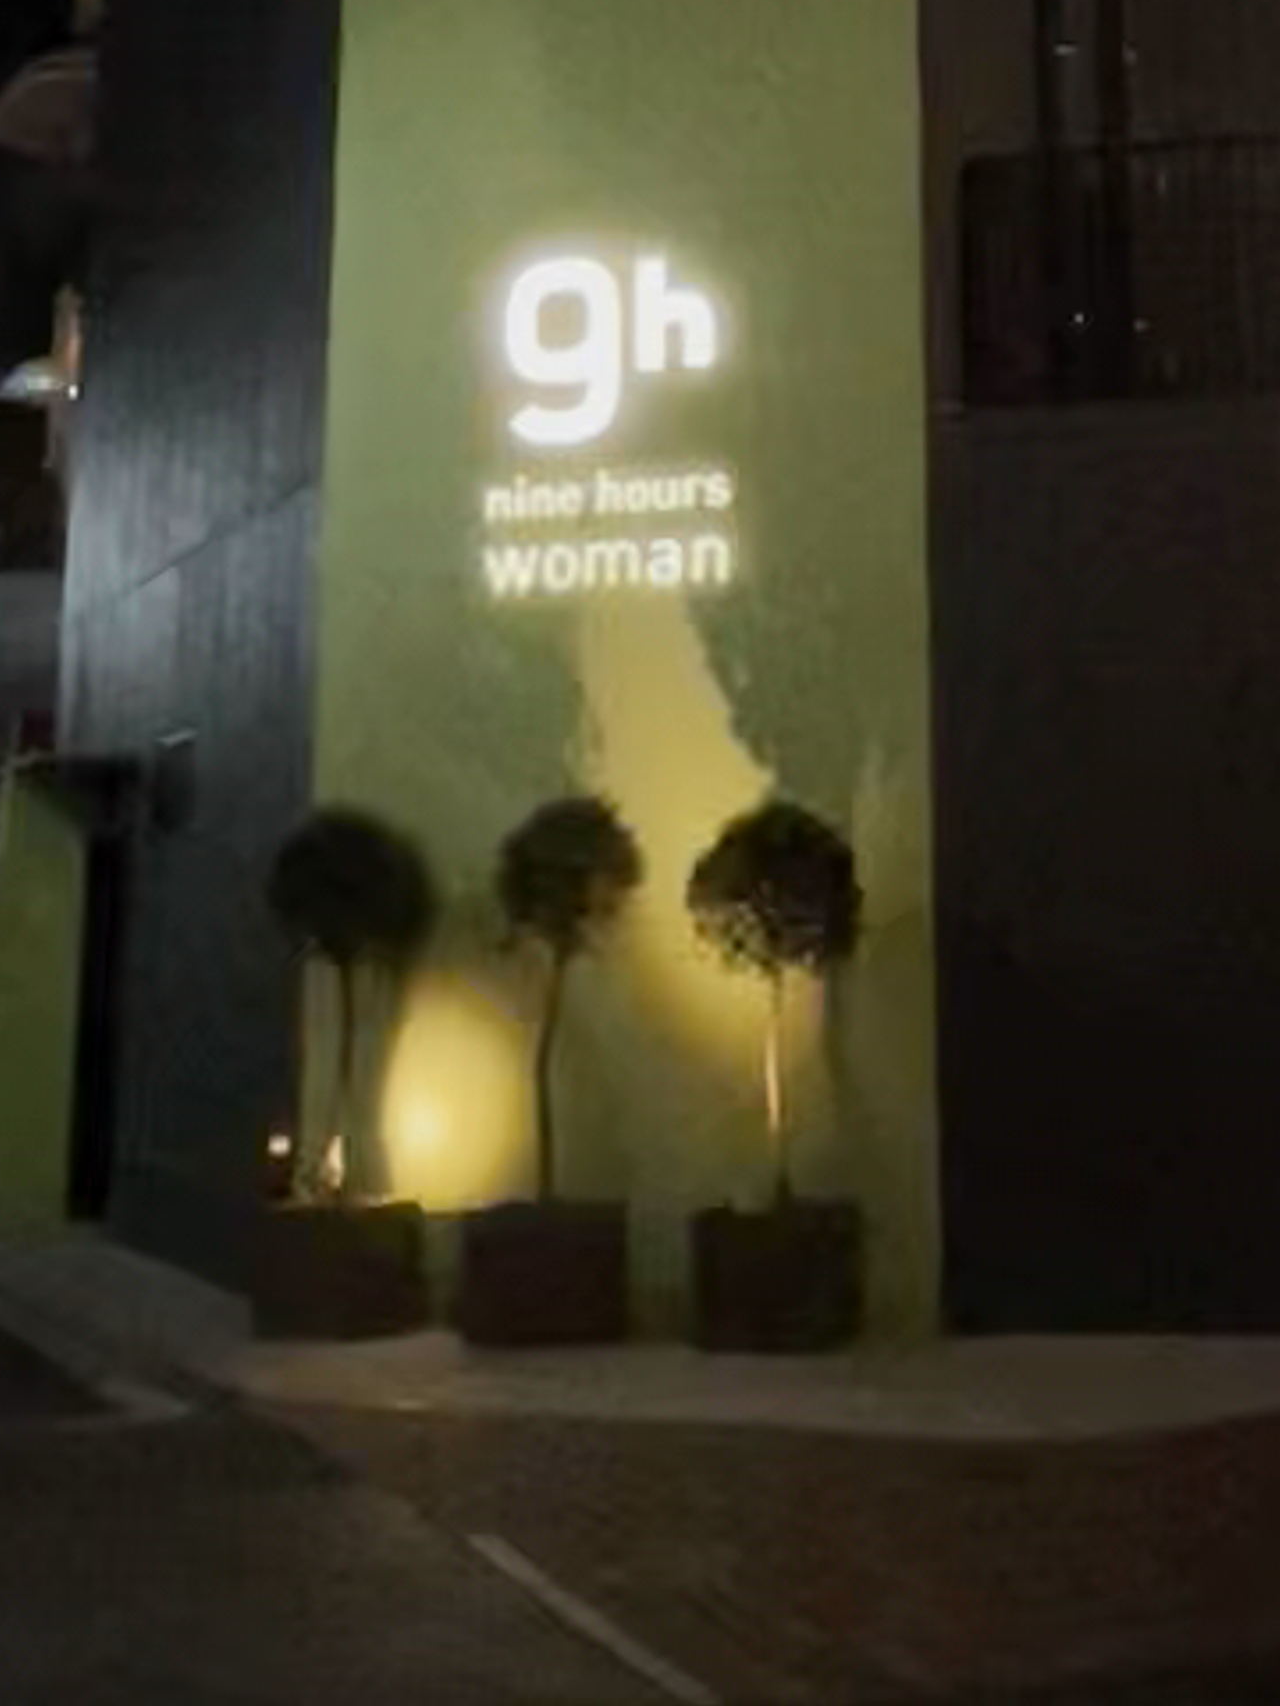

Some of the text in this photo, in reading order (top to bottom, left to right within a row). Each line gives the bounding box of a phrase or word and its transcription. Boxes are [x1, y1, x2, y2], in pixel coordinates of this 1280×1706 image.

[483, 469, 733, 522] nine hours
[482, 532, 731, 599] woman
